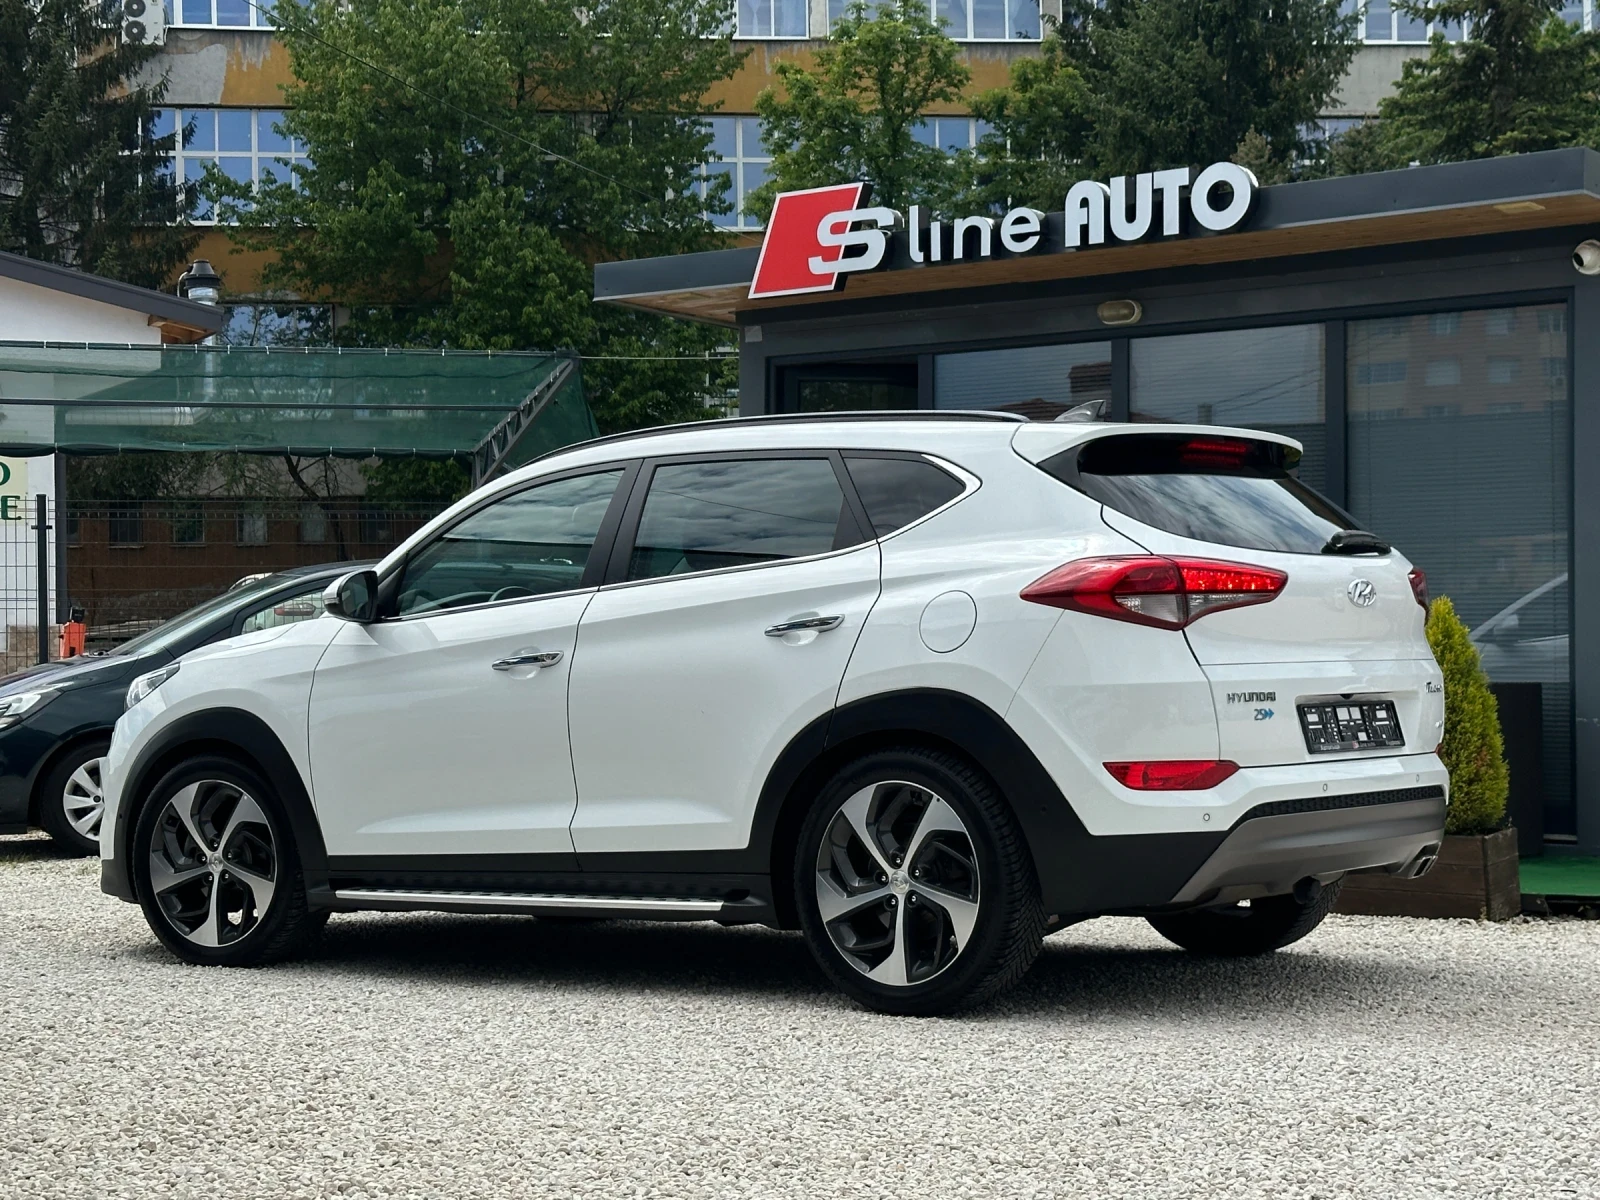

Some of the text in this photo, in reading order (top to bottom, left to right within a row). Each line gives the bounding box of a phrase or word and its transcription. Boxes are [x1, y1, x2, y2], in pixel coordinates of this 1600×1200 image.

[909, 204, 1041, 263] line
[1065, 161, 1252, 247] AUTO
[1226, 691, 1276, 704] HYUNDAI
